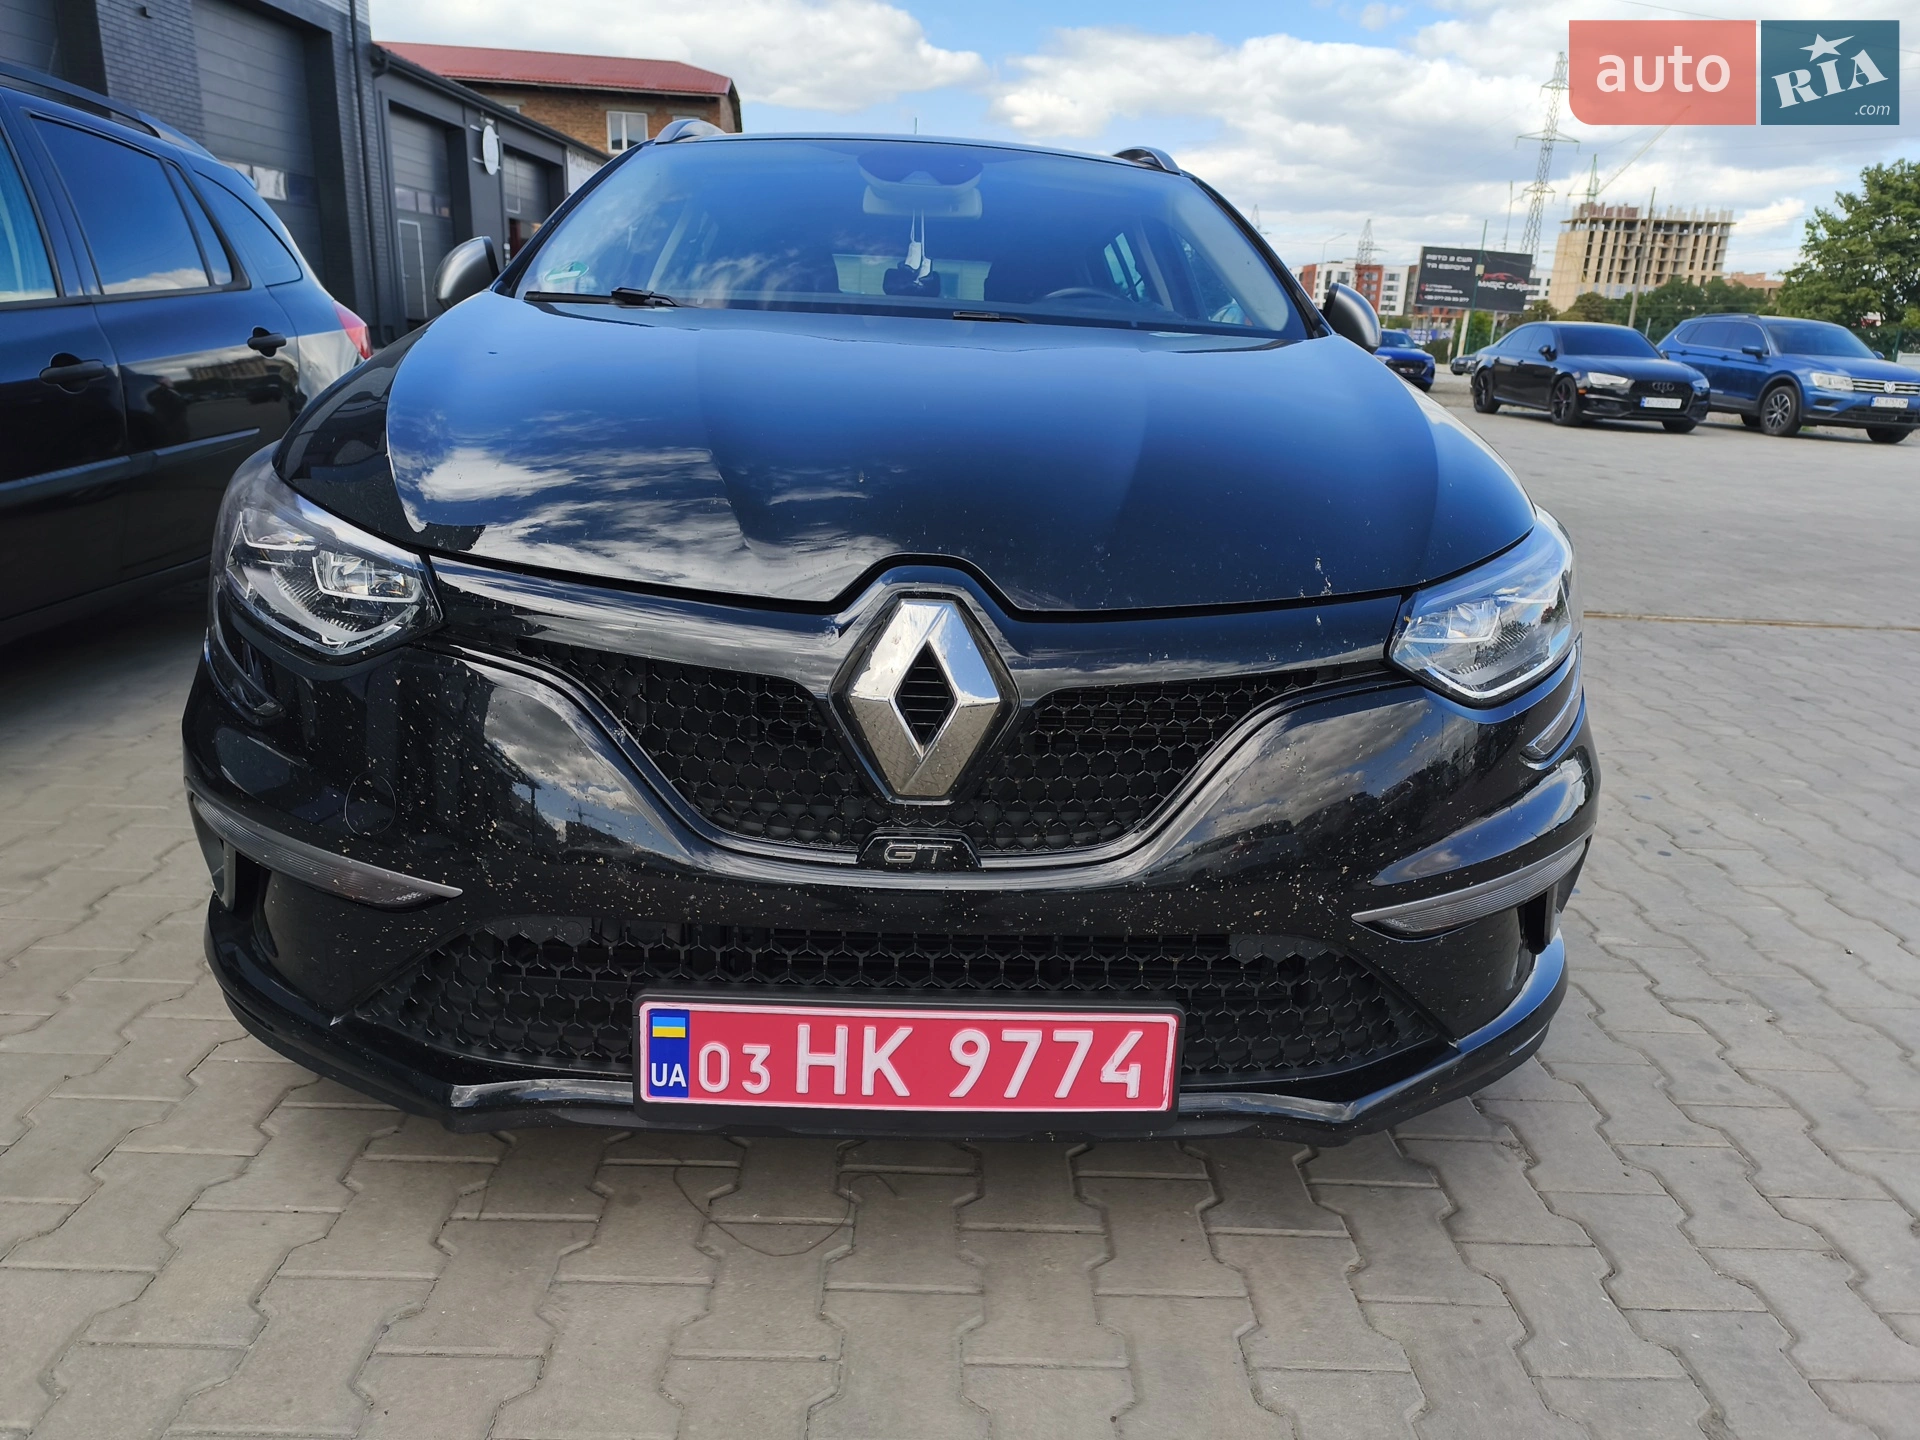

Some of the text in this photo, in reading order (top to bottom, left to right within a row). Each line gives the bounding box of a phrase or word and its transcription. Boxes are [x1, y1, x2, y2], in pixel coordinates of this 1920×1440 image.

[884, 844, 953, 864] GT
[698, 1024, 1144, 1099] 03 HK 9774
[650, 1063, 687, 1089] UA
